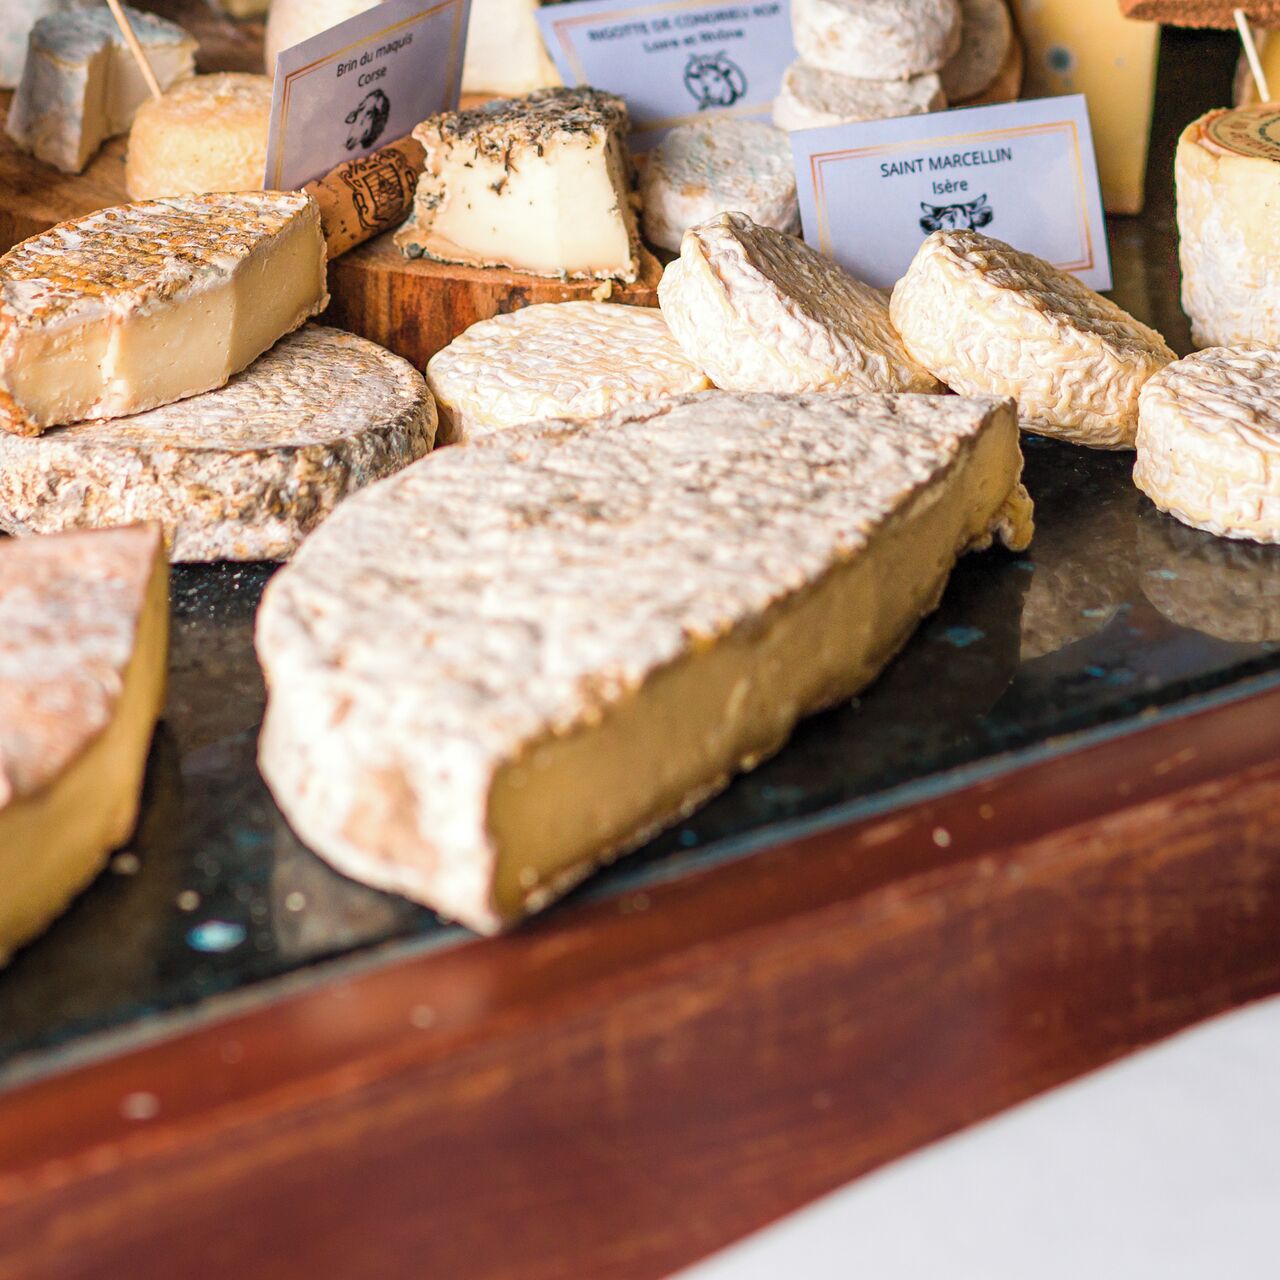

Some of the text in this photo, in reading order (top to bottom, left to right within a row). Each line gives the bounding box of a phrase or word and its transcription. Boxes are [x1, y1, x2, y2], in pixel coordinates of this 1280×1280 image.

[336, 32, 414, 78] Brin du maquis
[357, 65, 387, 88] Corse
[880, 148, 1013, 178] SAINT MARCELLIN
[932, 178, 969, 195] Isère
